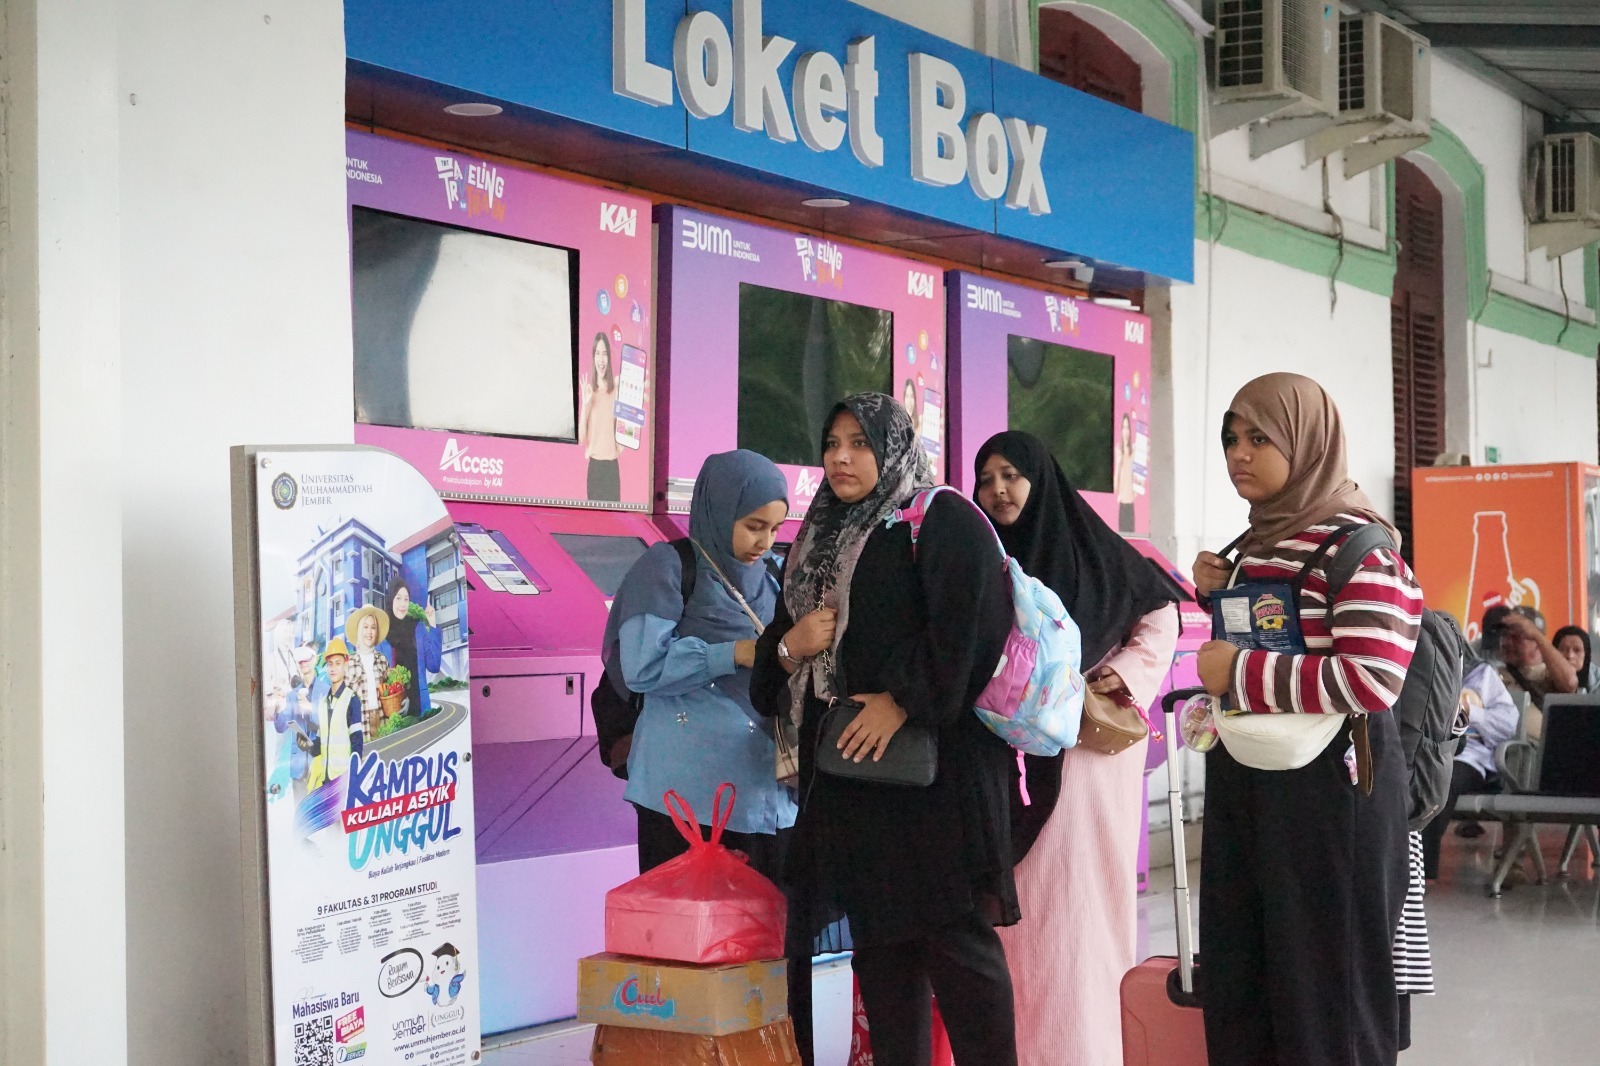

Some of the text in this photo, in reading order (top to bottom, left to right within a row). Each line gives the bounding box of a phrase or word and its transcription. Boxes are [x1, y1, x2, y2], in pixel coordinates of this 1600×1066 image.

[612, 0, 1051, 216] Loket Box
[345, 169, 383, 185] NDONESIA
[346, 157, 369, 170] NTUK
[599, 202, 637, 237] KAI
[907, 270, 934, 299] KAI
[1124, 320, 1144, 344] KAI
[439, 438, 504, 476] Access
[345, 750, 459, 809] KAMPUS
[346, 784, 450, 827] KULIAH ASYIK
[348, 803, 462, 870] UNGGUL
[317, 880, 438, 916] 9 FAKULTAS & 31 PROGRAM STUDI
[292, 997, 339, 1019] Mahasiswa
[341, 991, 360, 1006] Baru
[337, 1010, 358, 1030] FREE
[341, 1017, 364, 1037] BIAYA
[394, 1025, 466, 1052] www.unmuhjember.ac.id
